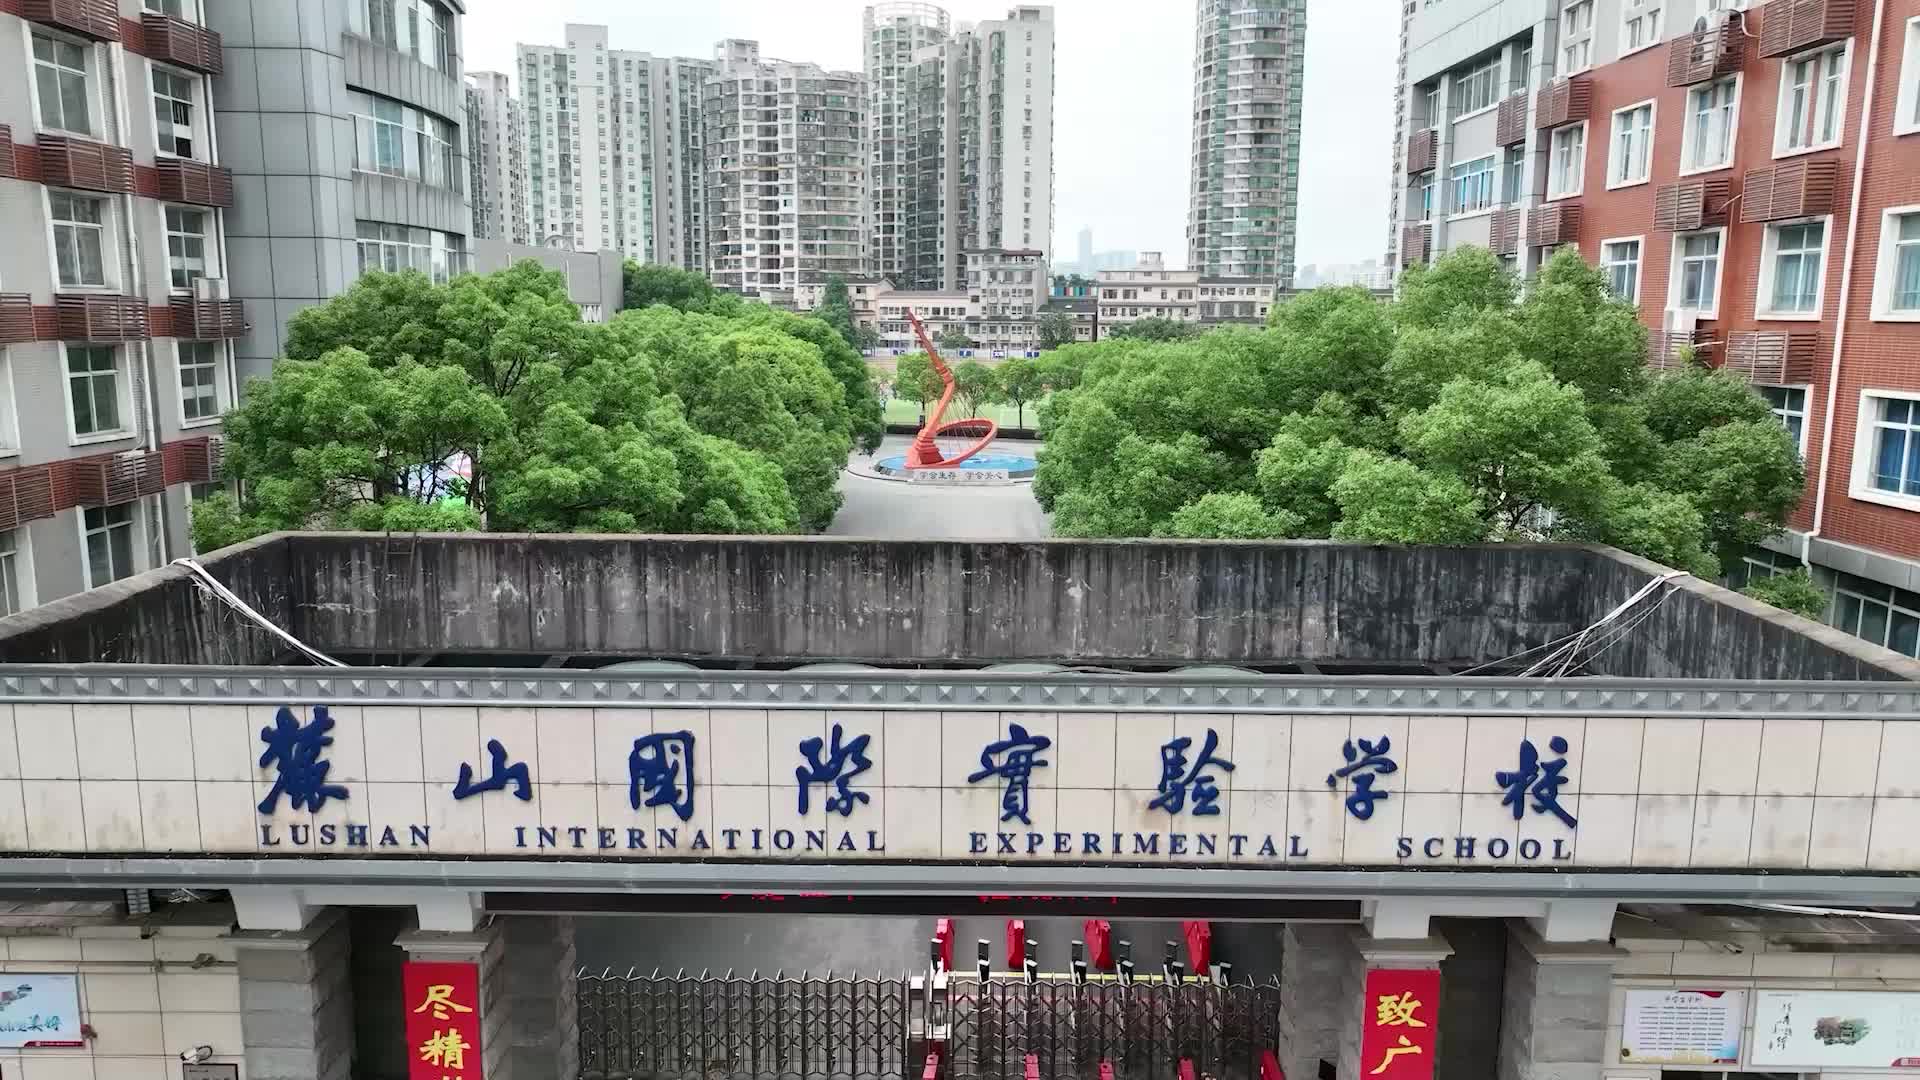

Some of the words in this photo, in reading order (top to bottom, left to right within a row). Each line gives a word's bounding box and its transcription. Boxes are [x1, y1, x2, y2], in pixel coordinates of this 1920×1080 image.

[262, 824, 431, 848] LUSHAN
[515, 826, 885, 851] INTERNATIONAL
[969, 831, 1309, 858] EXPERIMENTAL
[1396, 838, 1571, 860] SCHOOL
[413, 984, 473, 1080] 尽精
[1369, 991, 1427, 1075] 致广
